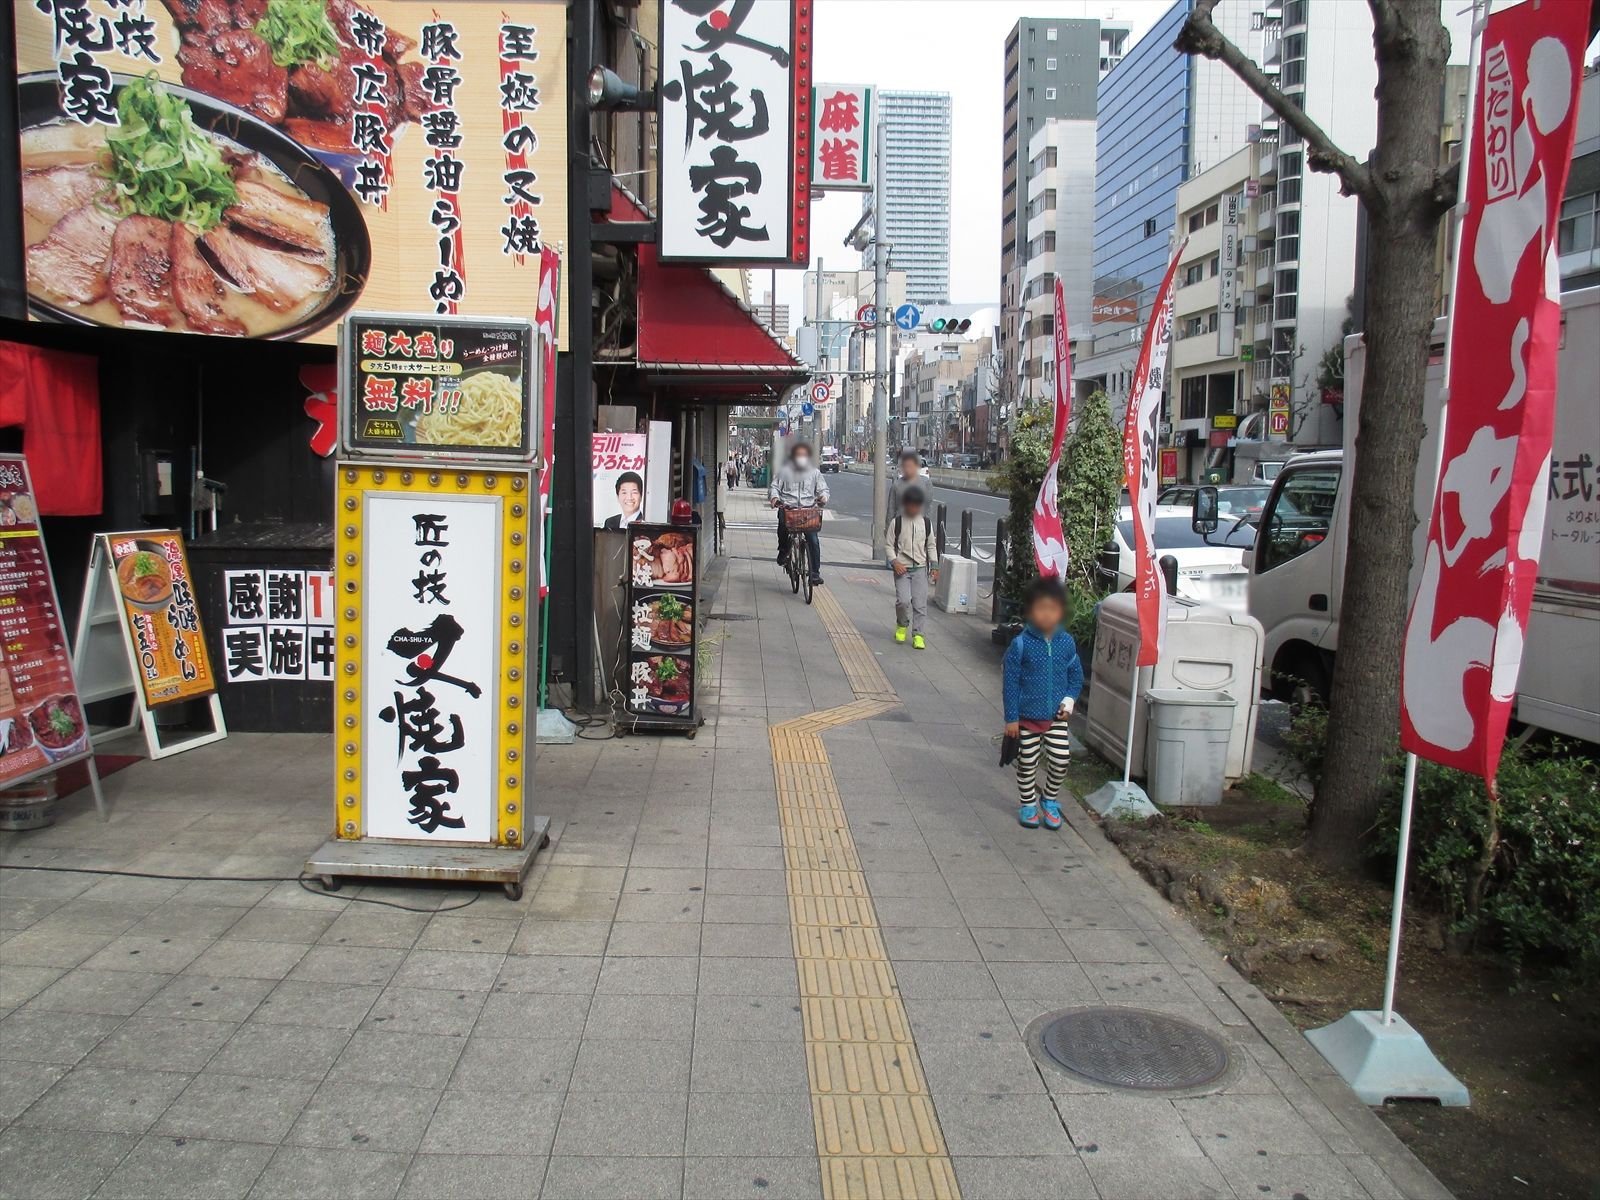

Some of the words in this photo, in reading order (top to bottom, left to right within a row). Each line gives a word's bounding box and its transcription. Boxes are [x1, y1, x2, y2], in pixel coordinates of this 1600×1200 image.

[351, 13, 391, 206] 帯広豚丼
[1487, 50, 1514, 193] こだわり
[499, 24, 543, 255] 至極の又焼
[818, 90, 860, 181] 麻雀
[420, 22, 465, 315] 豚骨醤油らーめ
[362, 329, 454, 359] 麺大盛り
[363, 375, 462, 415] 無料!!
[592, 436, 621, 454] 石川
[592, 453, 647, 471] ひろたか
[411, 513, 451, 606] 匠の技
[632, 537, 654, 588] 又焼
[228, 573, 334, 621] 感謝1
[167, 604, 198, 682] らーめん
[393, 635, 433, 645] CHA-SHU-YA
[631, 601, 652, 652] 拉麺
[228, 629, 334, 679] 実施中
[630, 661, 653, 711] 豚丼
[378, 613, 483, 834] 又焼家
